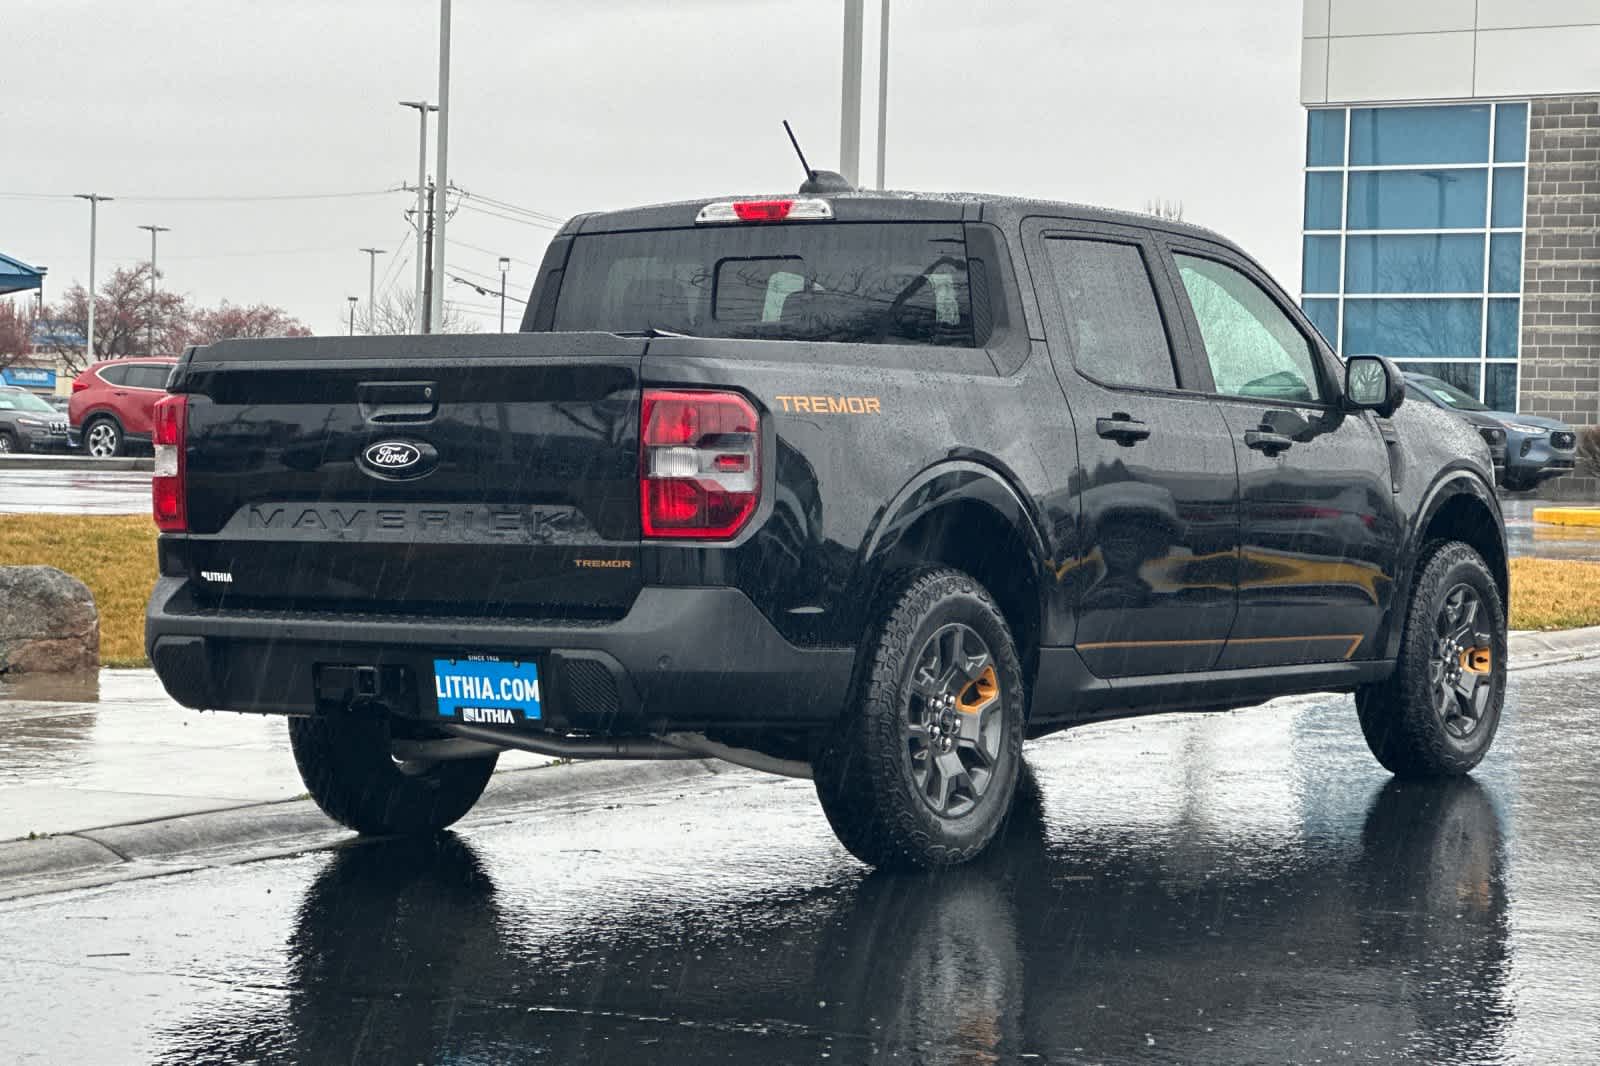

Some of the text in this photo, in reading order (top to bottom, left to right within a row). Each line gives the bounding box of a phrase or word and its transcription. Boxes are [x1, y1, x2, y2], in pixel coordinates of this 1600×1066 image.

[775, 395, 881, 415] TREMOR
[376, 445, 409, 464] Ford
[249, 505, 574, 538] MAVERICK
[575, 559, 632, 568] TREMOR
[207, 571, 233, 583] LITHIA
[435, 674, 540, 703] LITHIA.COM
[474, 708, 515, 724] LITHIA
